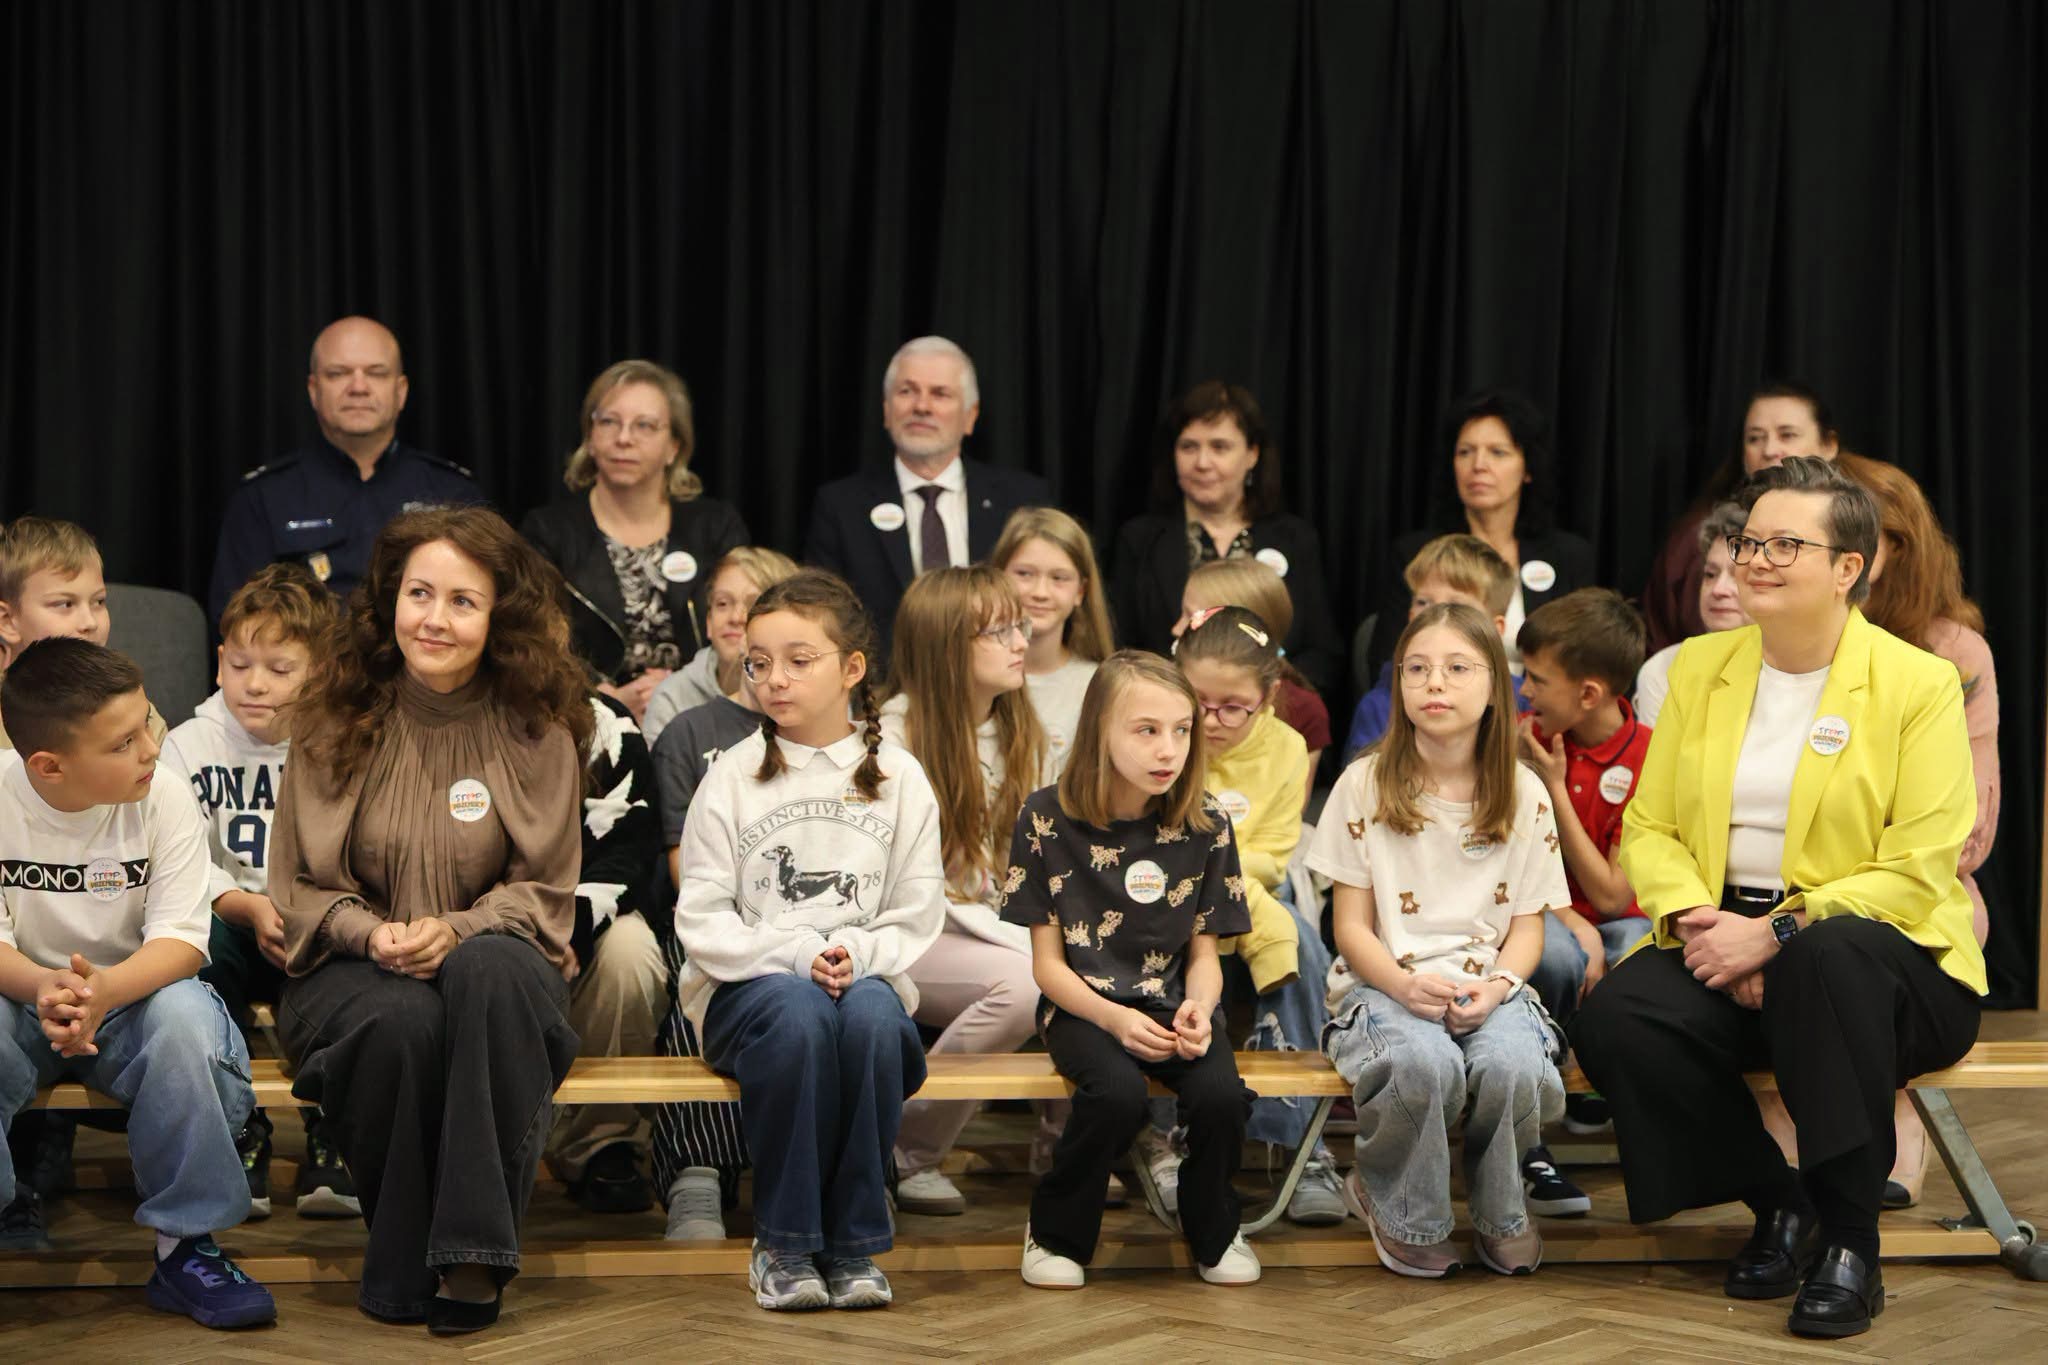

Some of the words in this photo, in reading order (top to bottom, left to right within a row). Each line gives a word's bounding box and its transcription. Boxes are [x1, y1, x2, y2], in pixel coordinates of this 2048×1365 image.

[227, 814, 267, 868] 9
[737, 802, 845, 858] DISTINCTIVE
[1, 862, 149, 890] MONOY
[862, 869, 882, 890] 78
